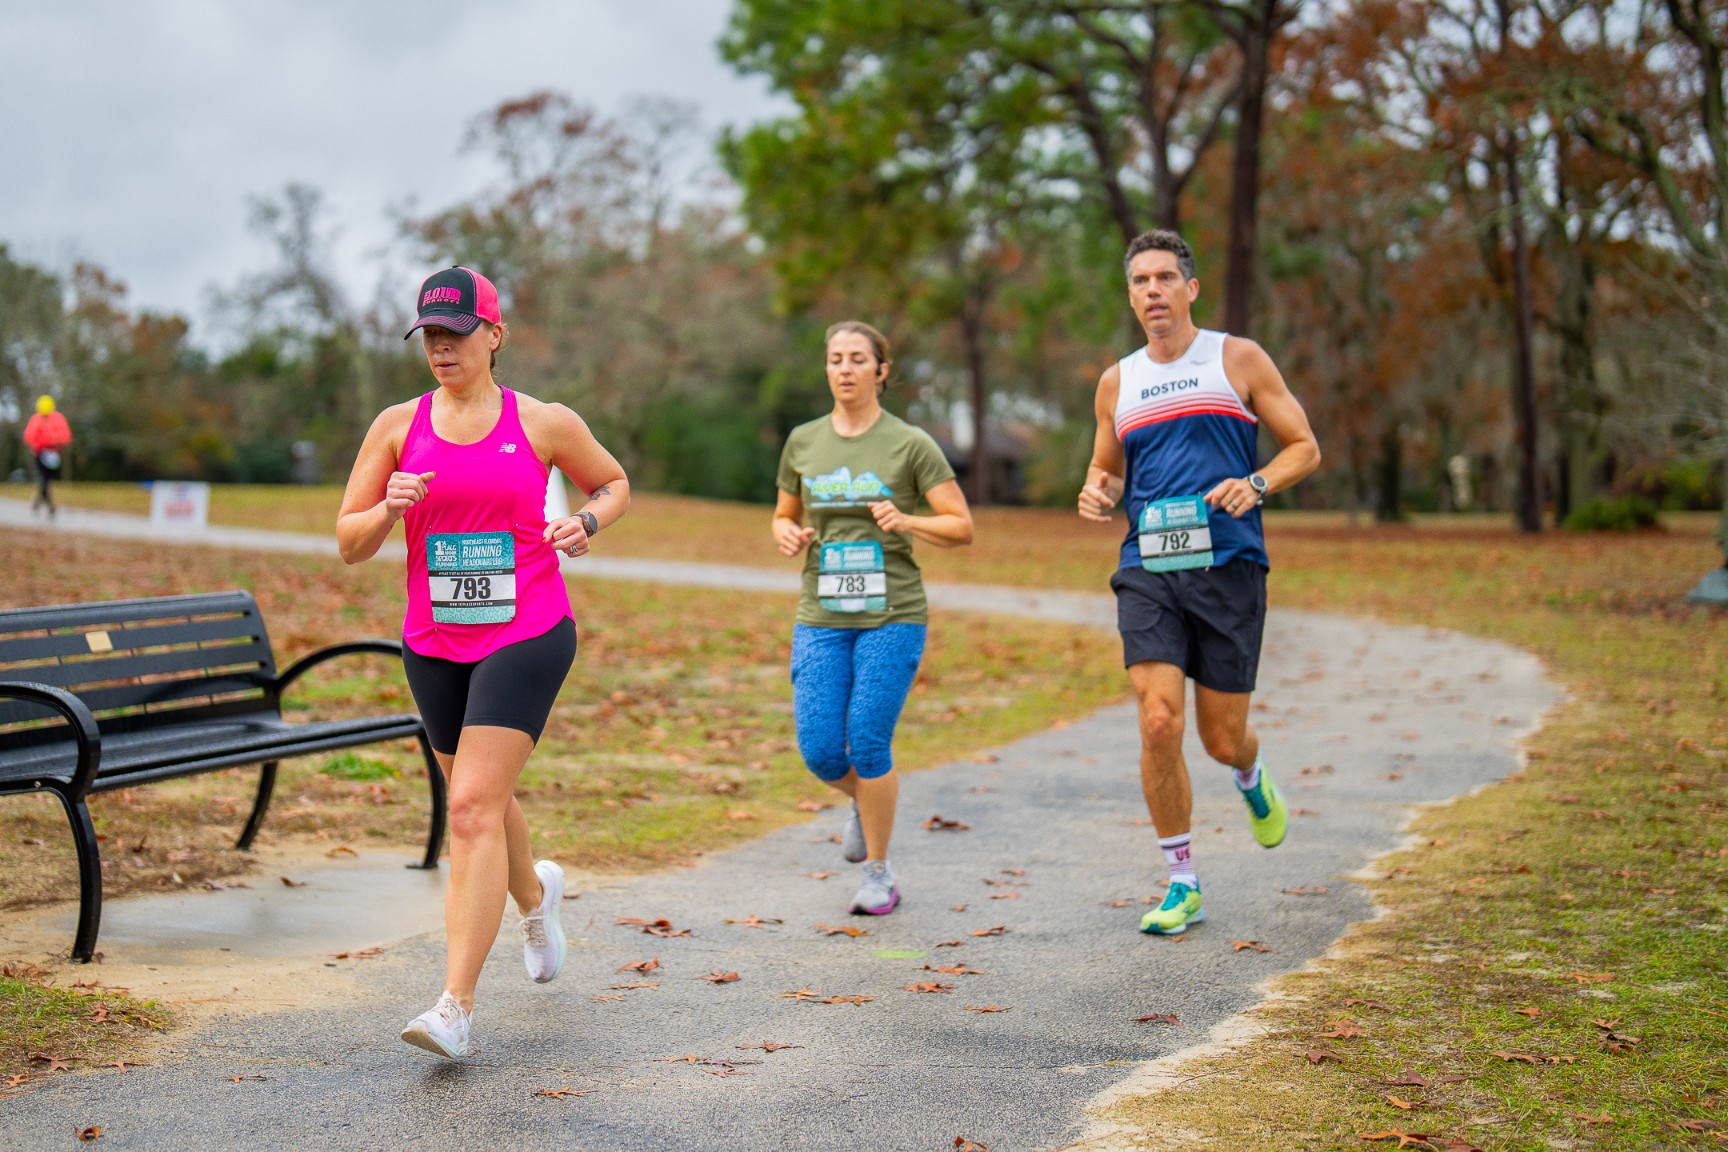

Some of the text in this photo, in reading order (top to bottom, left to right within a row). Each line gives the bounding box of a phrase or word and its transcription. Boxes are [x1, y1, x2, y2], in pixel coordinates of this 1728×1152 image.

[1141, 378, 1199, 399] BOSTON
[1158, 531, 1191, 551] 792
[462, 545, 502, 558] RUNNING
[450, 577, 491, 600] 793
[836, 576, 865, 593] 783
